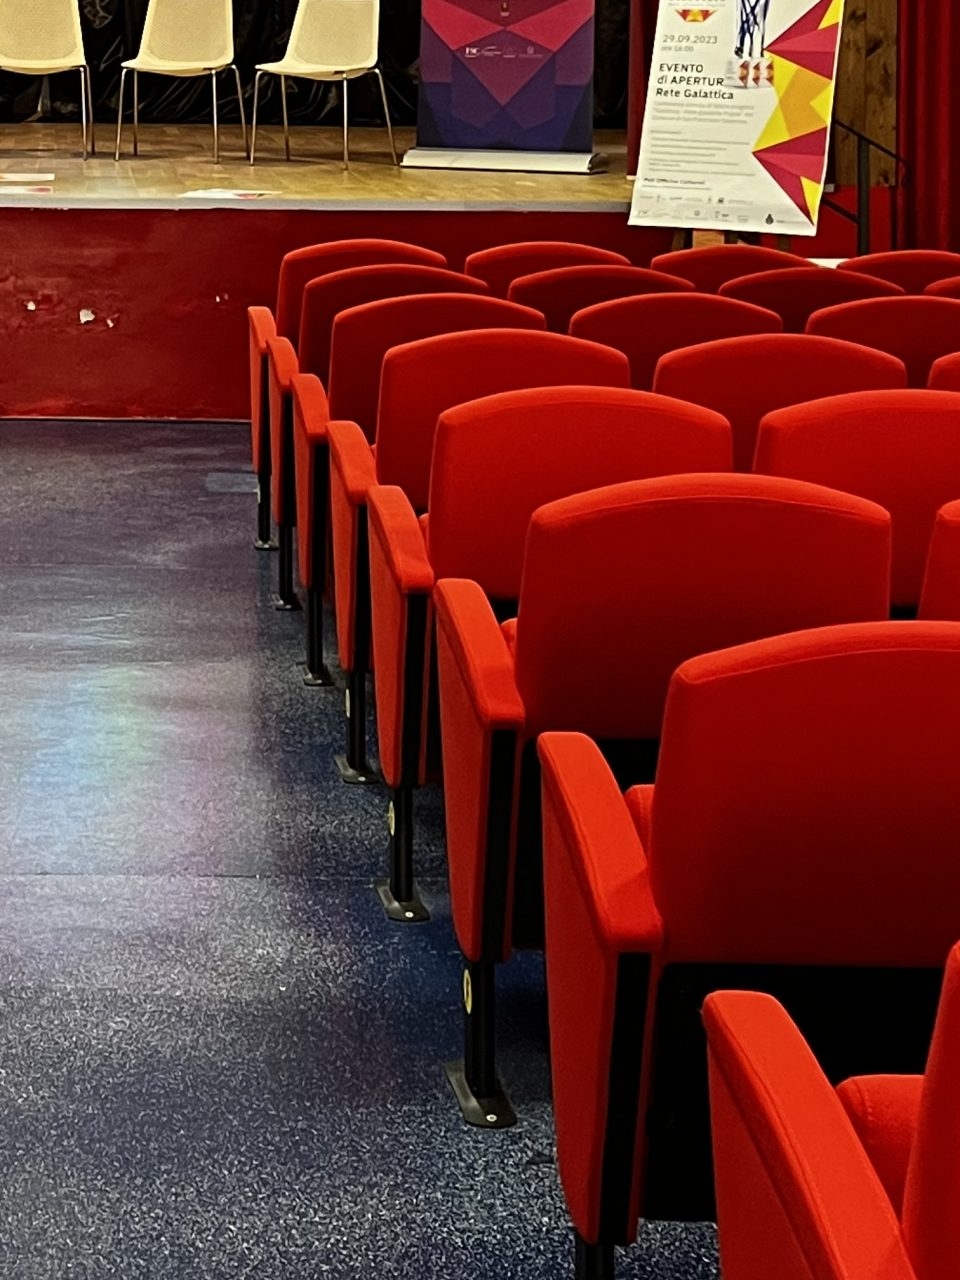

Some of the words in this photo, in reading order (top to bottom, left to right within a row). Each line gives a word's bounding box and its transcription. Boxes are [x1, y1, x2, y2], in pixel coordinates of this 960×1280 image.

[662, 34, 719, 45] 29.09.2023
[659, 63, 704, 74] EVENTO
[657, 74, 668, 85] di
[670, 75, 725, 87] APERTUR
[655, 88, 681, 98] Rete
[683, 88, 735, 100] Galattica
